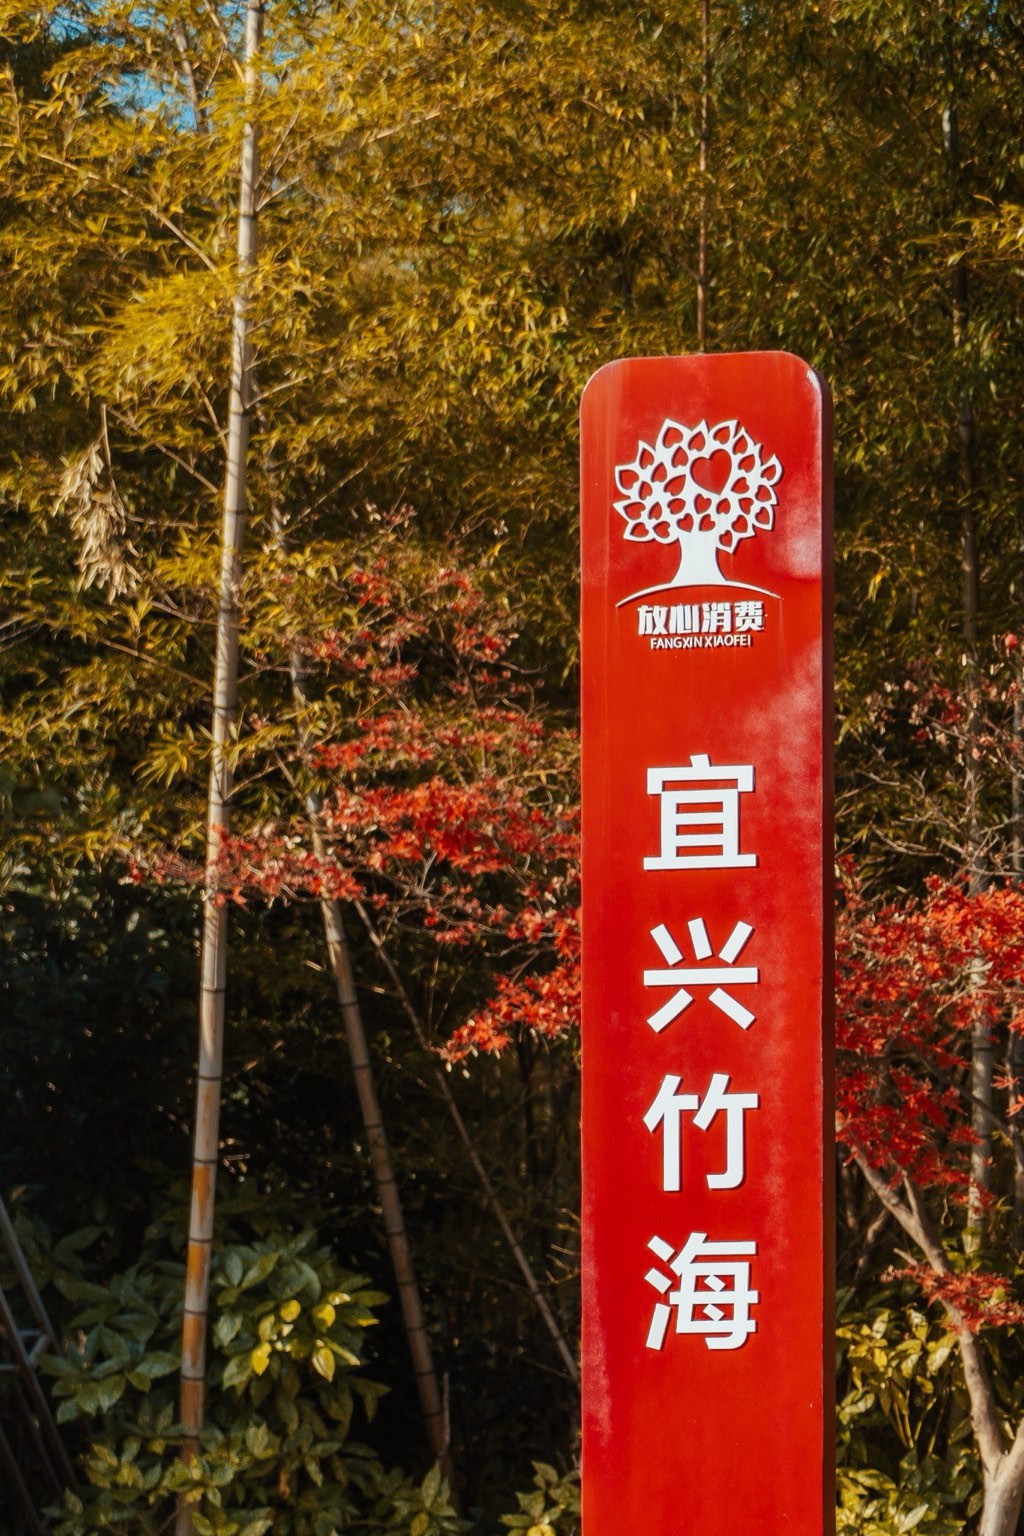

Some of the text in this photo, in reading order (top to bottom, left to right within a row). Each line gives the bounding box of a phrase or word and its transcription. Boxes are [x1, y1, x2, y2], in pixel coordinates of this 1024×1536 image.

[637, 601, 764, 635] 放心消费
[650, 634, 751, 649] FANGXIN XIAOFEI
[643, 753, 759, 1351] 宜兴竹海
